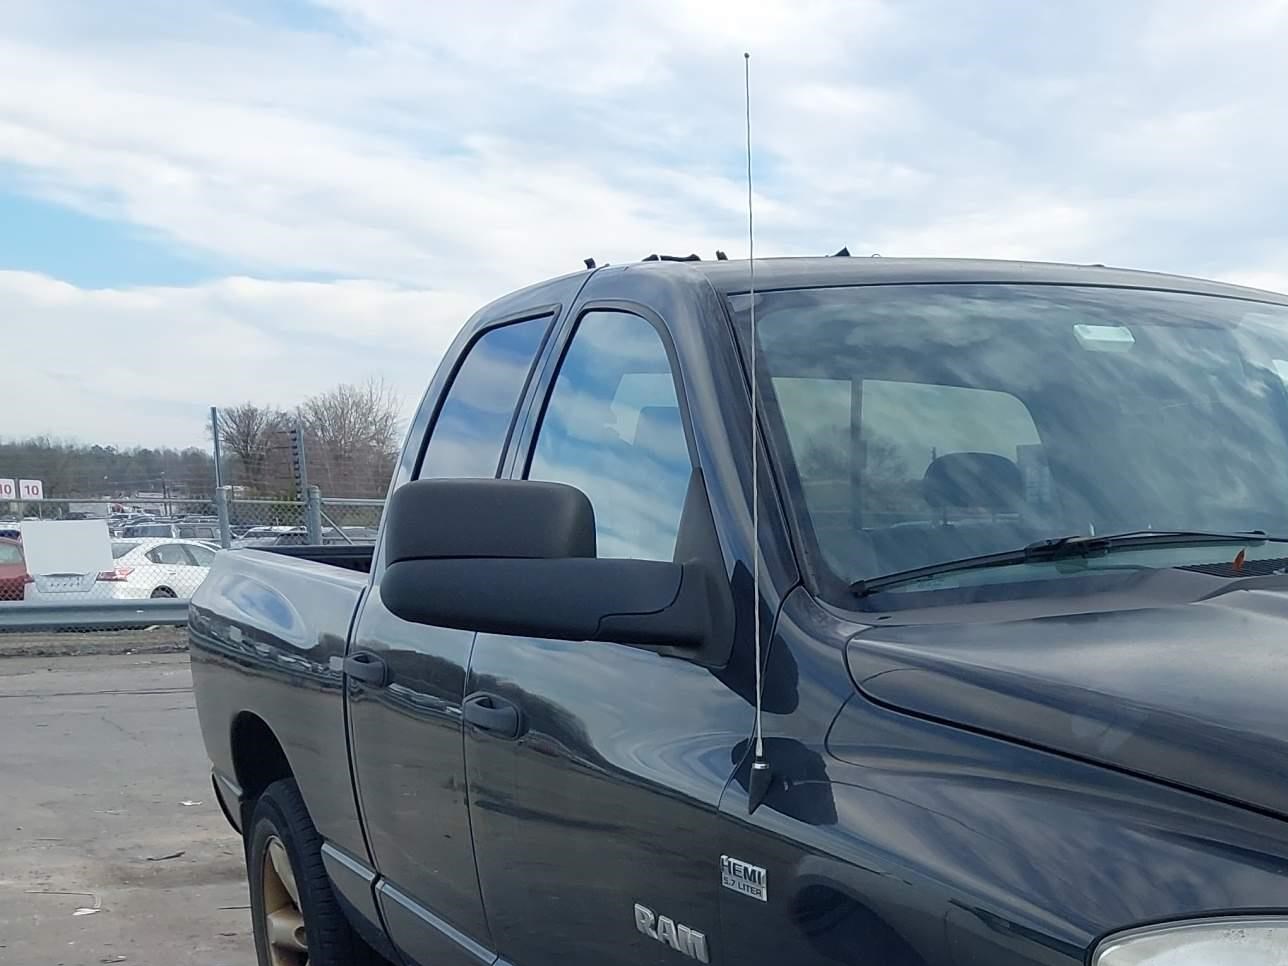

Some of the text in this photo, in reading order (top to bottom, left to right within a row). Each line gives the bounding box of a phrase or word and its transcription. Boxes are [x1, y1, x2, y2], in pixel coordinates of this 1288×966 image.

[24, 485, 40, 496] 10
[720, 856, 762, 885] HEMI
[723, 874, 762, 898] 5.7 LITER
[634, 903, 709, 964] RAM
